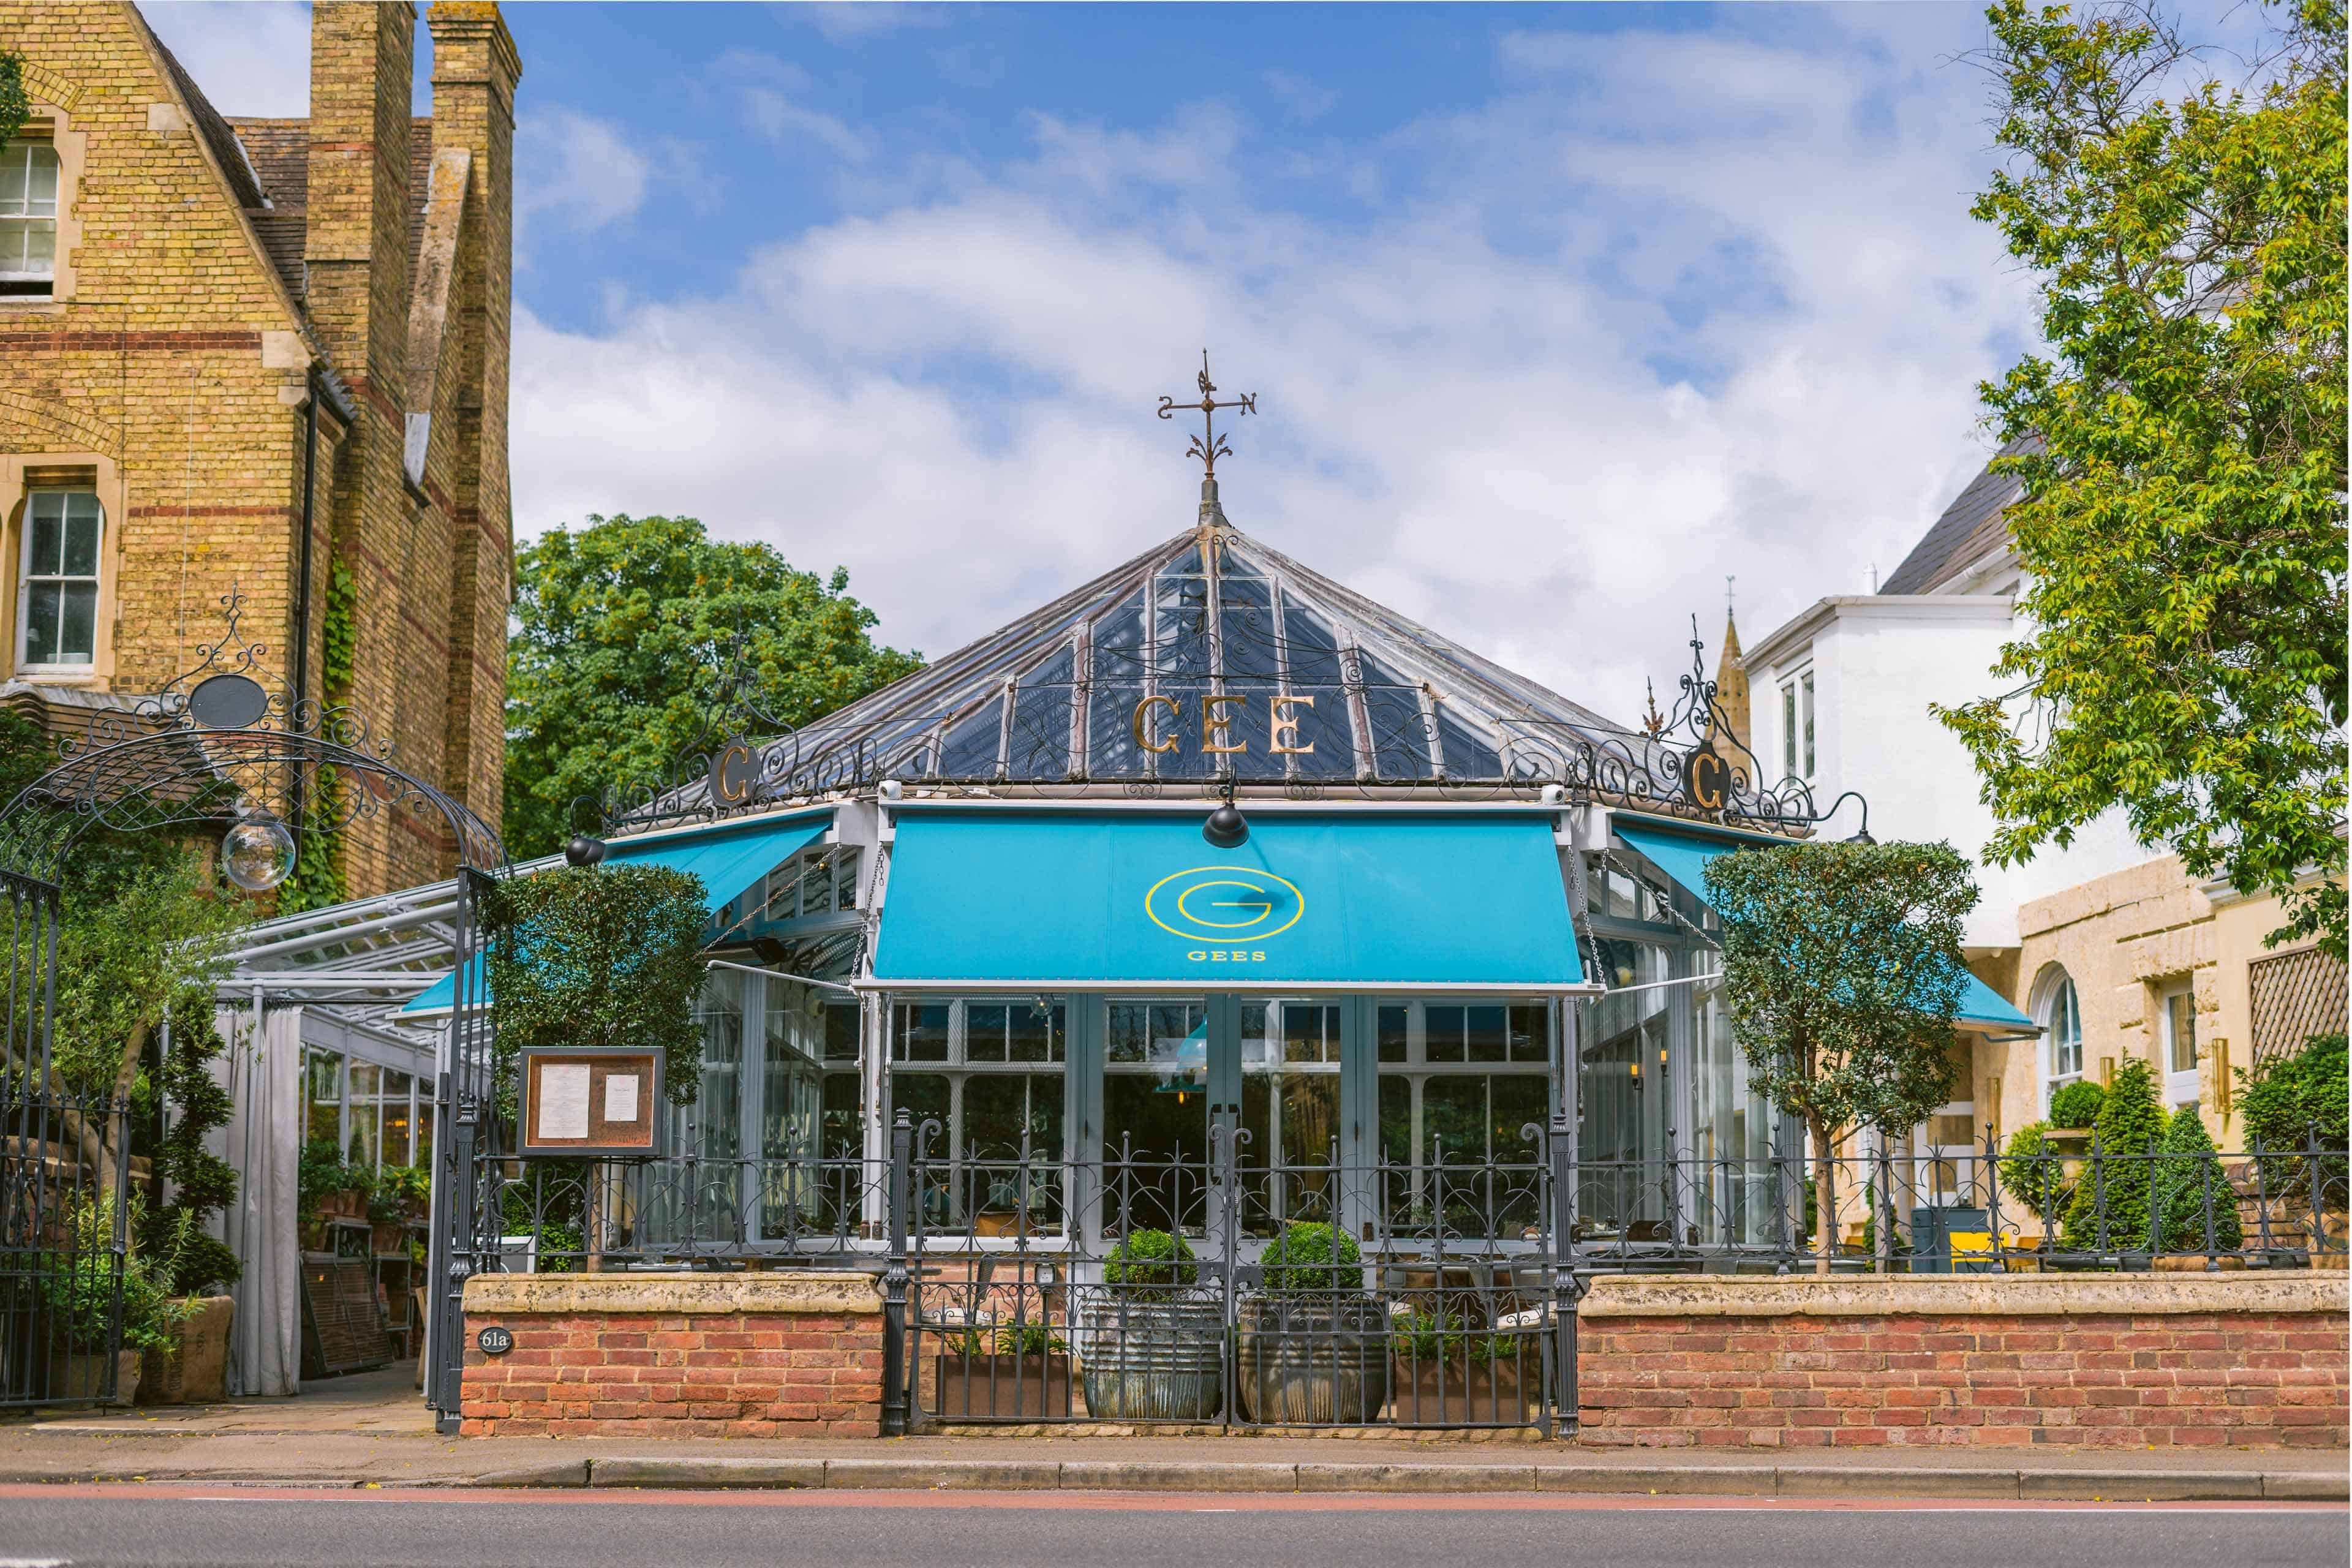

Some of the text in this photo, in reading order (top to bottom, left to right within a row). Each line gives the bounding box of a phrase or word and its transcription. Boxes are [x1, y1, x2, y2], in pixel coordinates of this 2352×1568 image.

[1240, 392, 1257, 416] N
[1133, 695, 1314, 755] GEE
[1178, 881, 1272, 928] G
[1188, 951, 1266, 961] GEES
[482, 1332, 507, 1346] 61a
